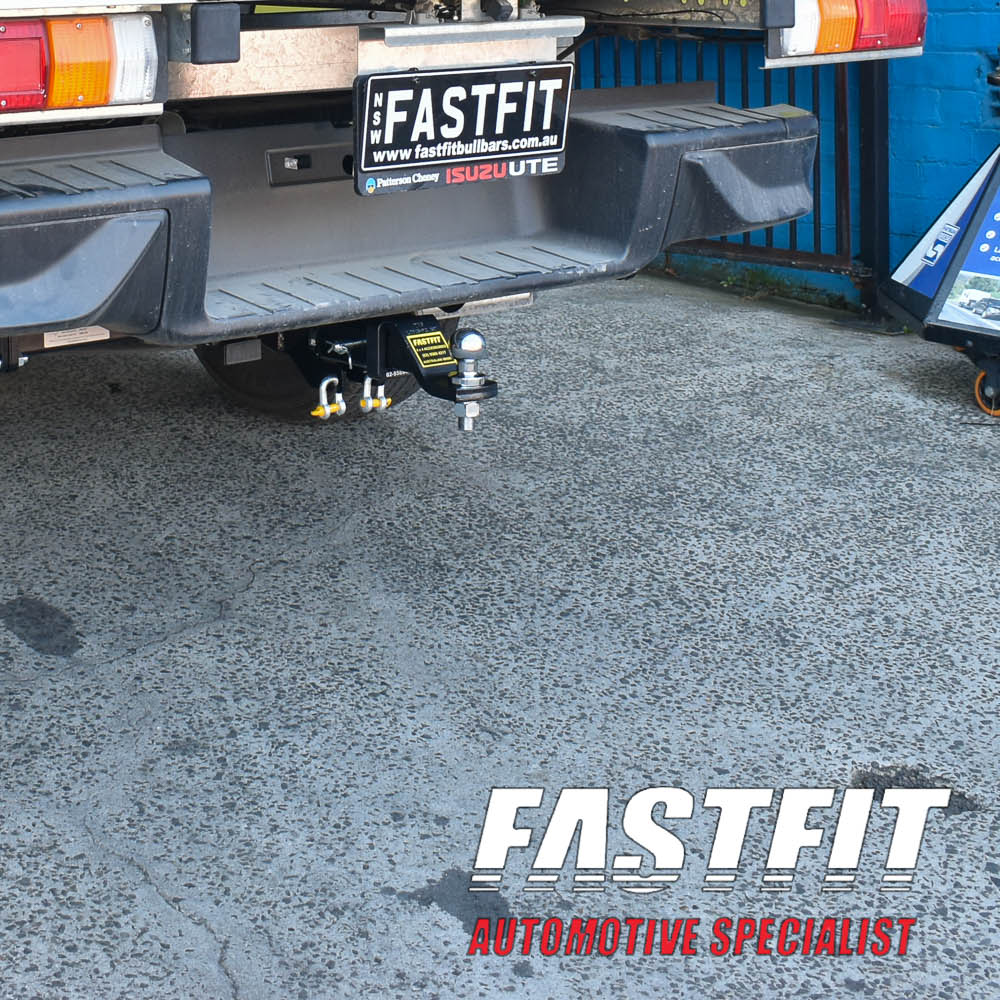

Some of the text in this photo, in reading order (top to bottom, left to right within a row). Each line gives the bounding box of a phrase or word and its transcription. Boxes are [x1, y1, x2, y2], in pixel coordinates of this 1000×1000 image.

[384, 78, 563, 145] FASTFIT
[373, 132, 558, 163] wwwfastfitbullbars.com.au
[377, 157, 559, 188] Patterson Cheney ISUZU UTE
[412, 336, 441, 346] FASTFIT
